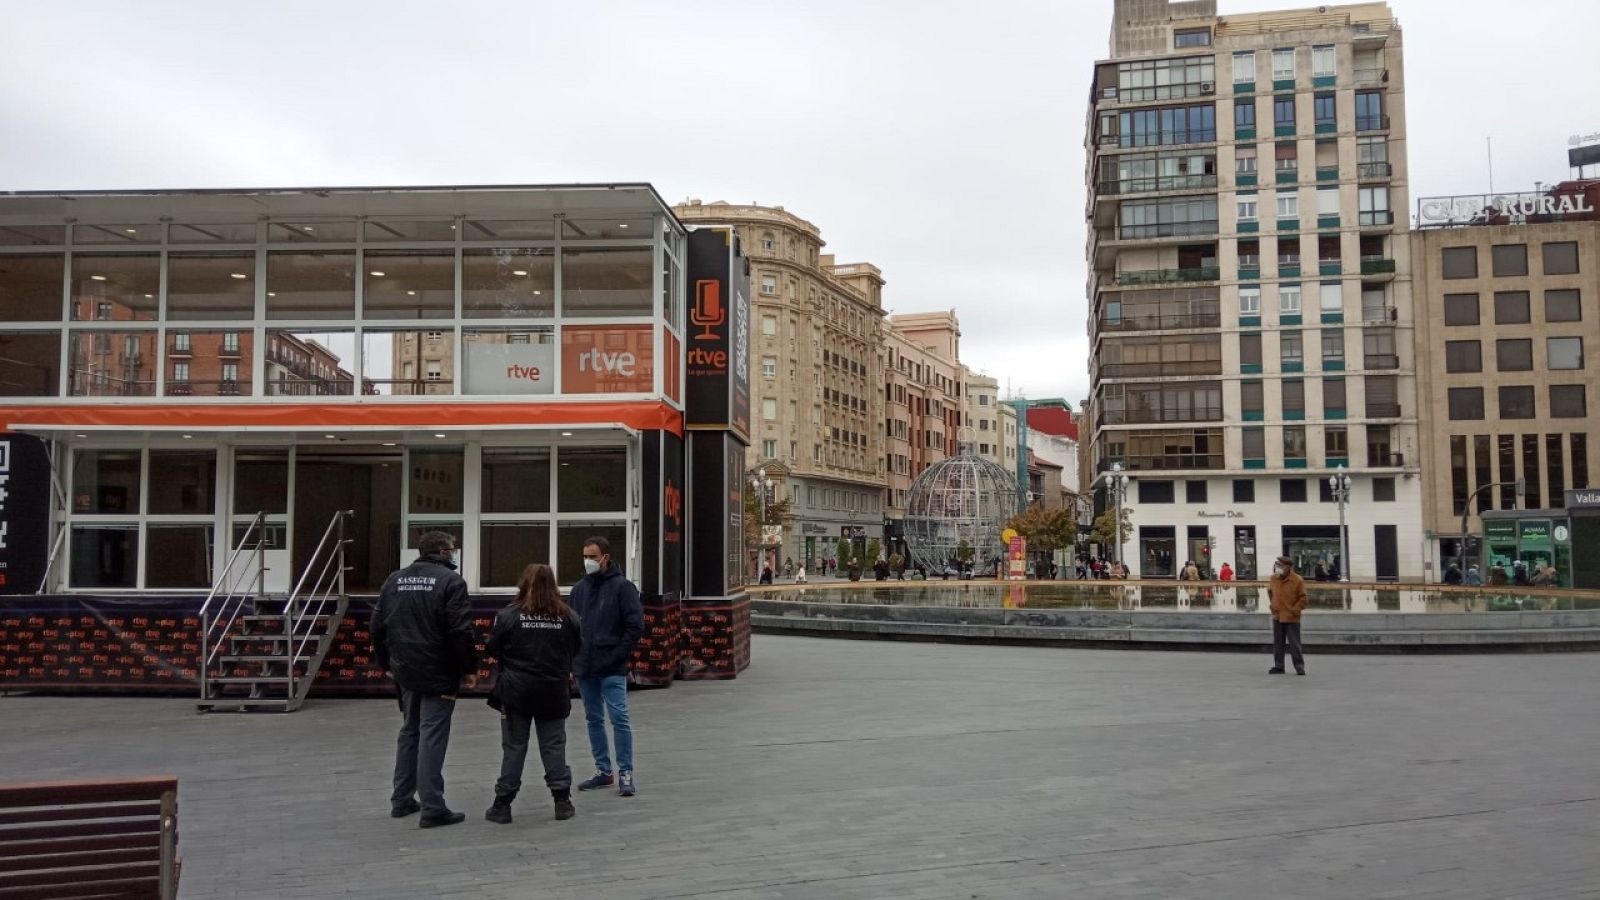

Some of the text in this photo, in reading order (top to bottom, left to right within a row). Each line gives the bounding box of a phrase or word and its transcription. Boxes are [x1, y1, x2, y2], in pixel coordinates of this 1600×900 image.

[1500, 194, 1594, 217] RURAL
[579, 347, 635, 376] rtve
[687, 348, 726, 368] rtve
[507, 364, 541, 381] rtve
[397, 576, 437, 585] SASEGUR
[520, 621, 562, 630] SEGURIDAD
